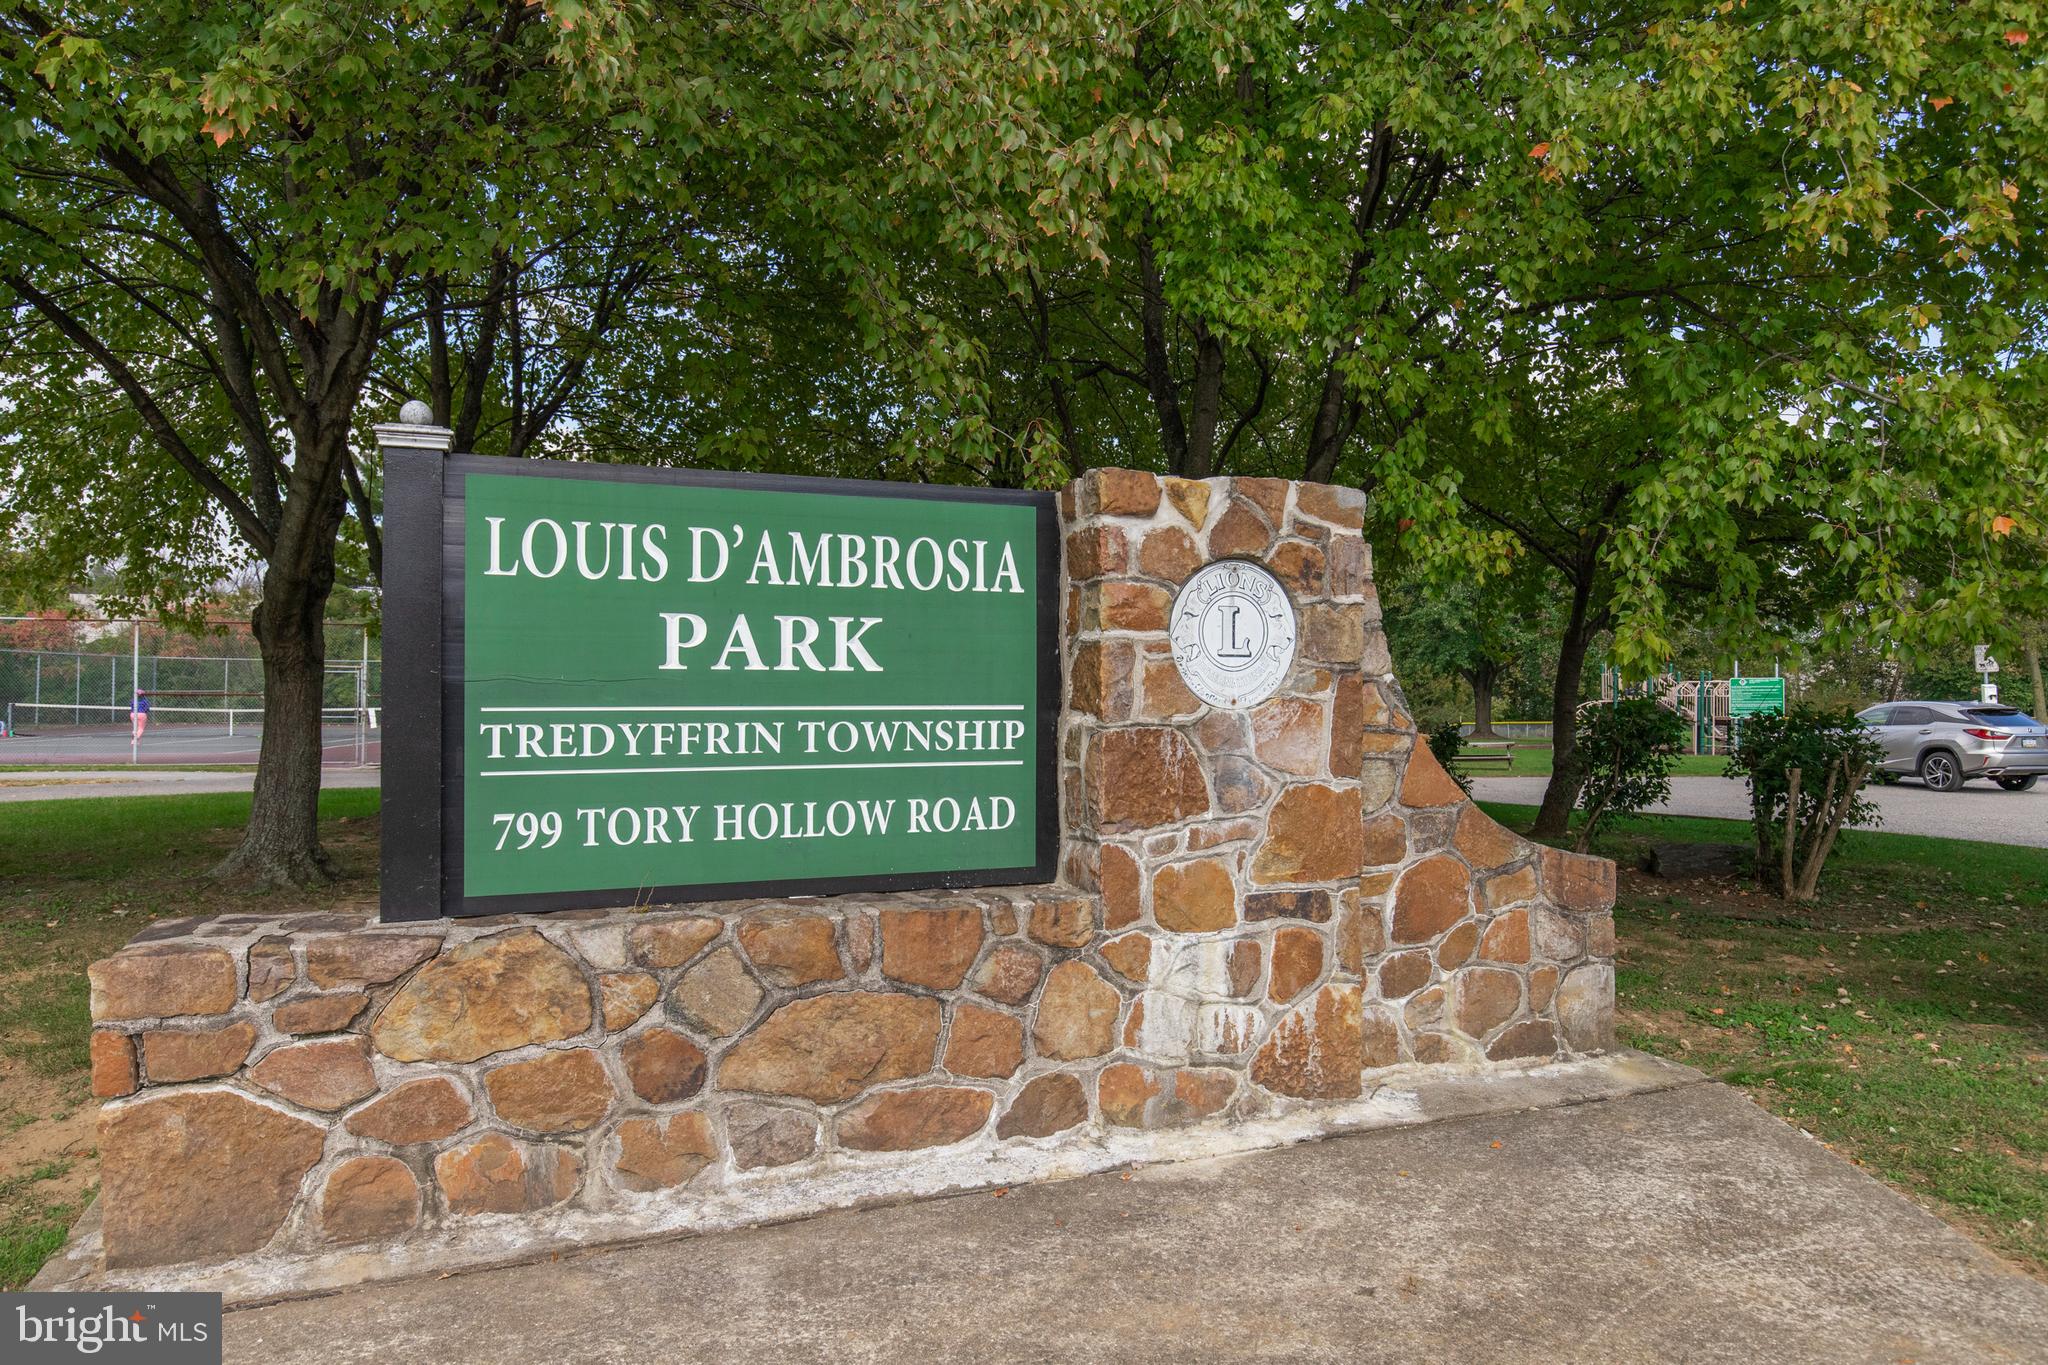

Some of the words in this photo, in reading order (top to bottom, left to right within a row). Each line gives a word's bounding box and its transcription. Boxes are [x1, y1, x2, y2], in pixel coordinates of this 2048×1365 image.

[484, 517, 669, 582] LOUIS
[1204, 573, 1267, 598] LIONS
[659, 613, 883, 671] PARK
[1217, 605, 1252, 657] L
[480, 721, 784, 759] TREDYFFRIN
[798, 720, 1025, 753] TOWNSHIP
[493, 811, 562, 851] 799
[577, 806, 700, 846] TORY
[714, 799, 895, 841] HOLLOW
[907, 797, 1015, 834] ROAD
